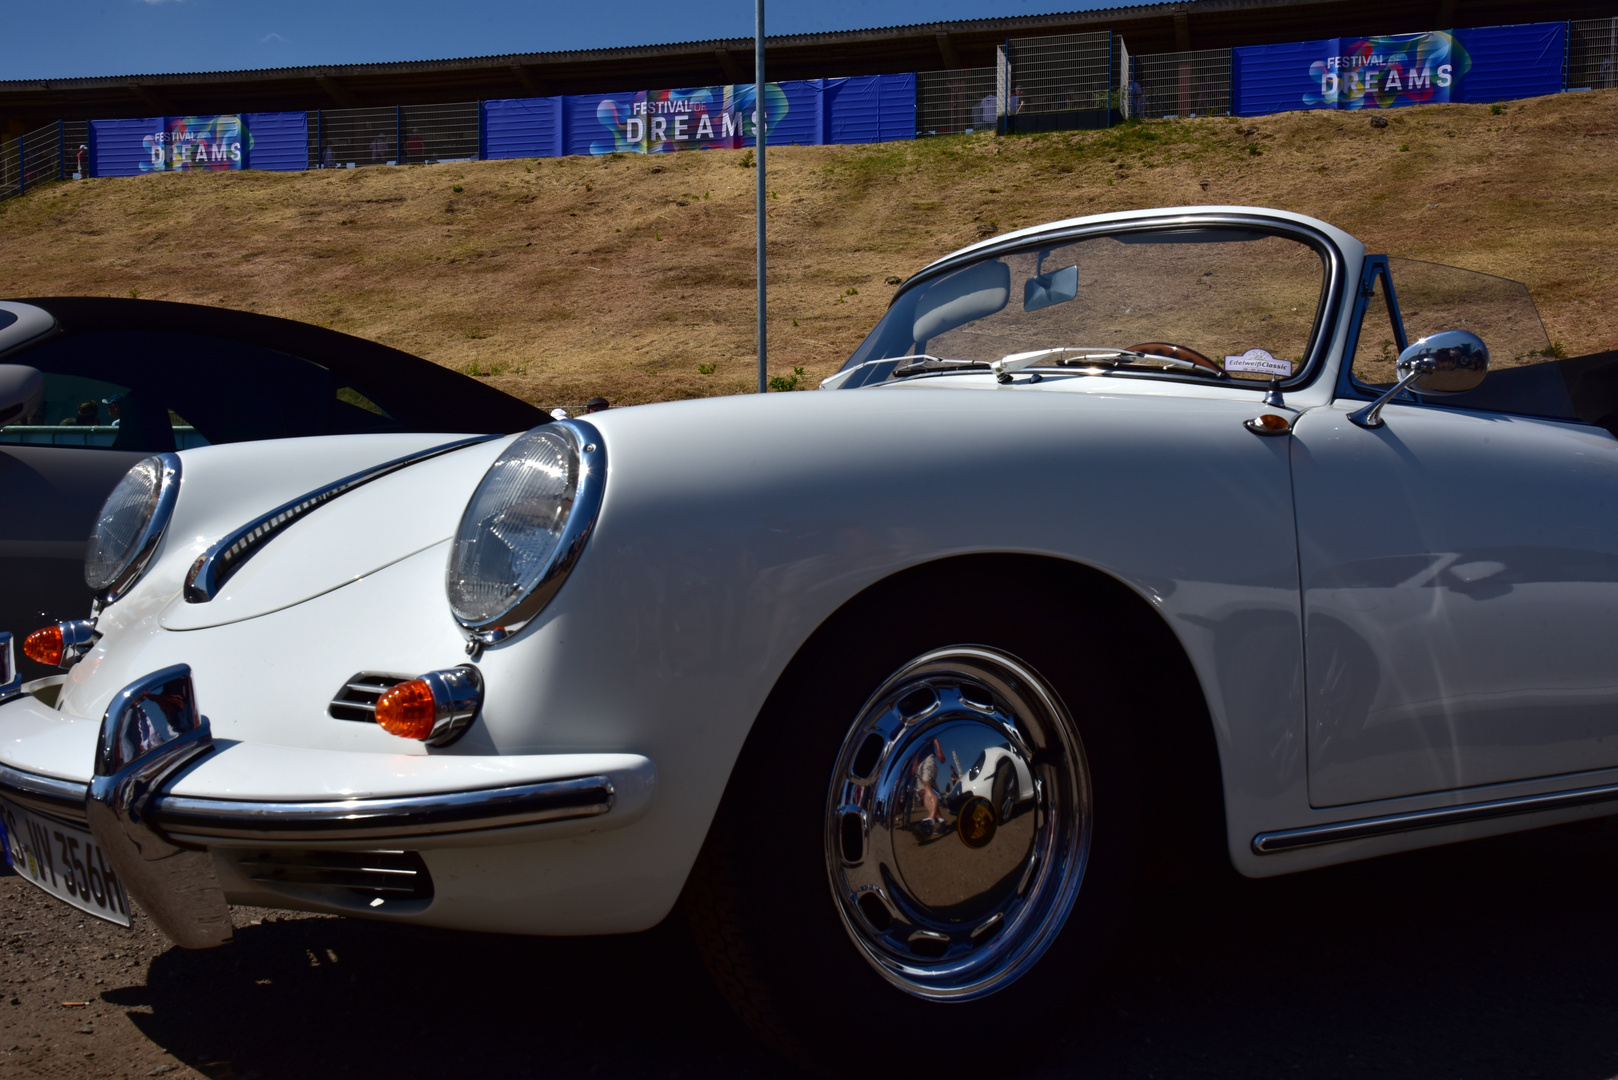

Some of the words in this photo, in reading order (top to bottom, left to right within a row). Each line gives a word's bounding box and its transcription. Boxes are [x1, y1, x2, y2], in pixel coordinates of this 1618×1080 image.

[1327, 55, 1387, 69] FESTIVAL
[1388, 55, 1400, 65] OF
[1321, 64, 1452, 95] DREAMS
[633, 100, 692, 115] FESTIVAL
[693, 101, 706, 112] OF
[155, 132, 196, 142] FESTIVAL
[151, 142, 241, 164] DREAMS
[53, 830, 126, 915] 356H
